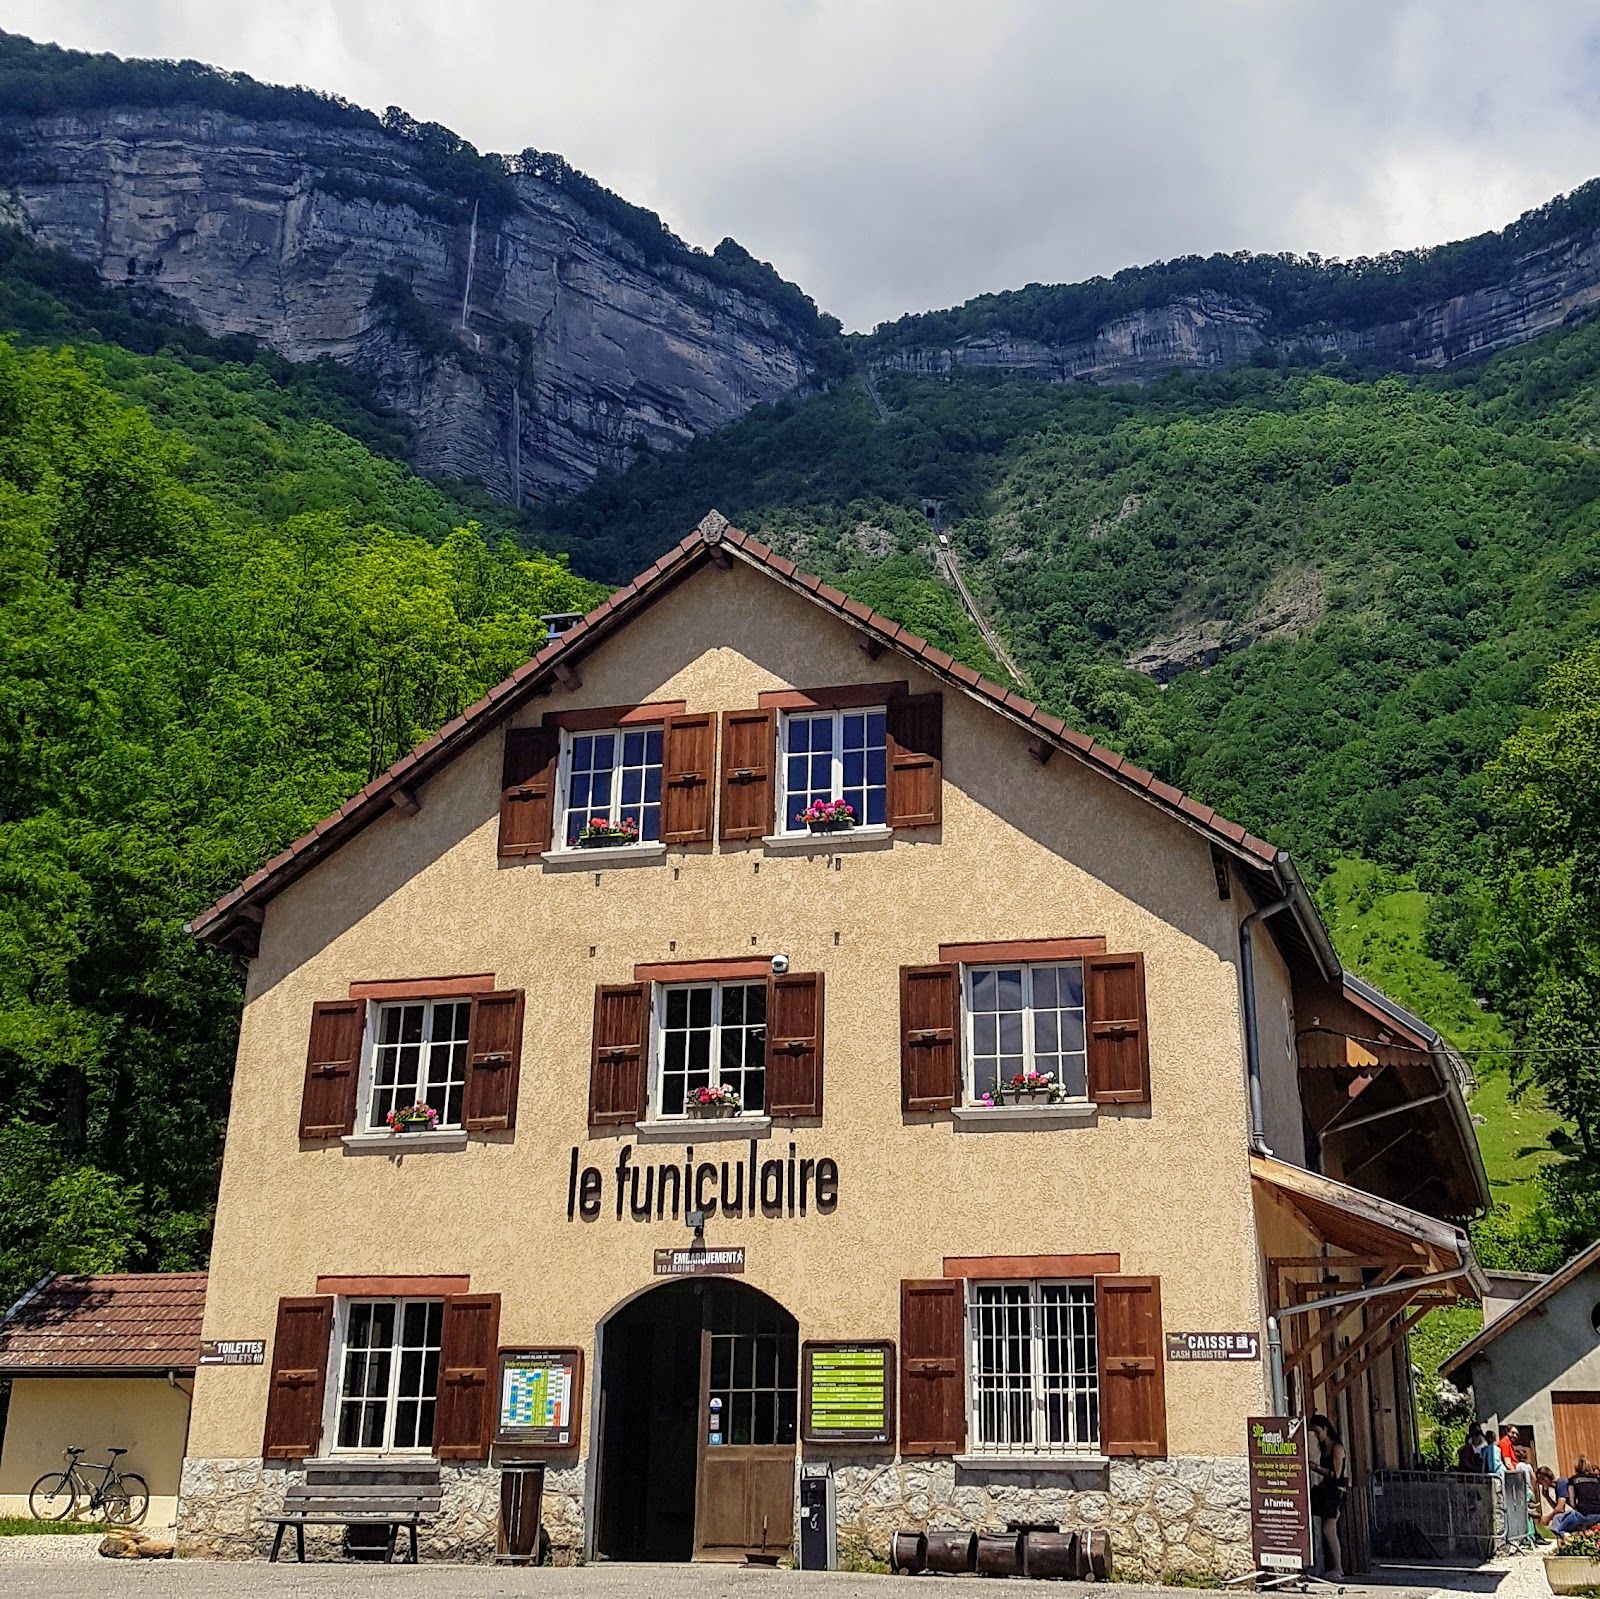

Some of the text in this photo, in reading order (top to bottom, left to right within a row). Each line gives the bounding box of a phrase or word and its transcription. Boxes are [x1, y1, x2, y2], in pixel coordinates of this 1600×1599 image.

[567, 1139, 839, 1219] le funiculaire
[673, 1251, 737, 1265] EMBARQUEMENT
[656, 1264, 695, 1273] BOARDING
[217, 1341, 263, 1354] TOILETTES
[1188, 1335, 1234, 1349] CAISSE
[223, 1354, 253, 1364] TOILETS
[1170, 1349, 1228, 1359] CASH REGISTER
